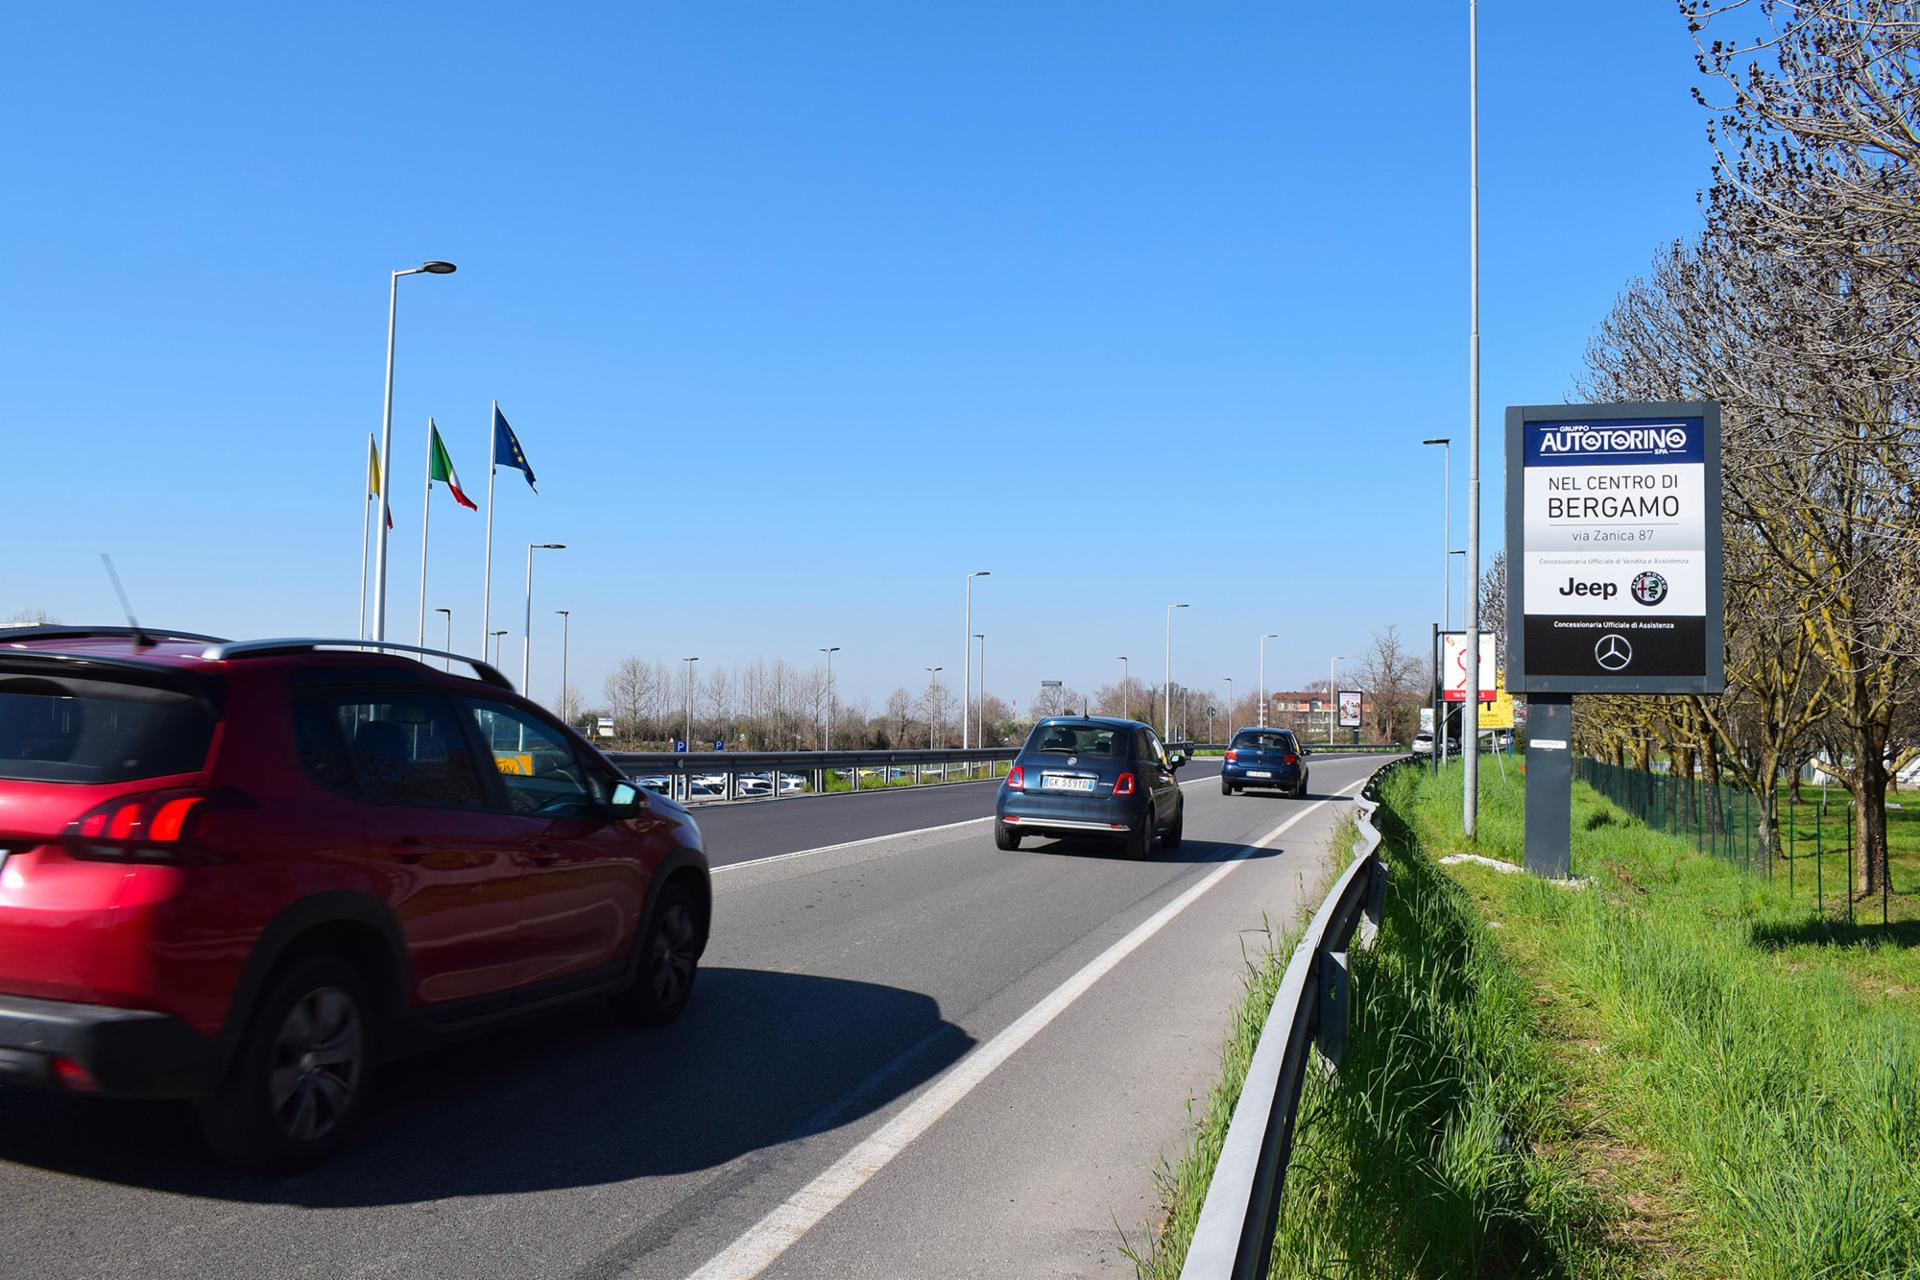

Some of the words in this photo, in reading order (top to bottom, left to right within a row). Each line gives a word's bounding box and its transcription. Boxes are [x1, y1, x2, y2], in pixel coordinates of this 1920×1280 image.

[1540, 428, 1687, 452] AUTOTORINO
[1549, 477, 1581, 490] NEL
[1587, 475, 1656, 490] CENTRO
[1662, 474, 1677, 489] DI
[1548, 495, 1679, 518] BERGAMO
[1572, 530, 1589, 541] via
[1594, 530, 1635, 541] Zanica
[1639, 529, 1654, 541] 87
[1559, 577, 1618, 600] Jeep
[1603, 621, 1629, 629] Ufficiale
